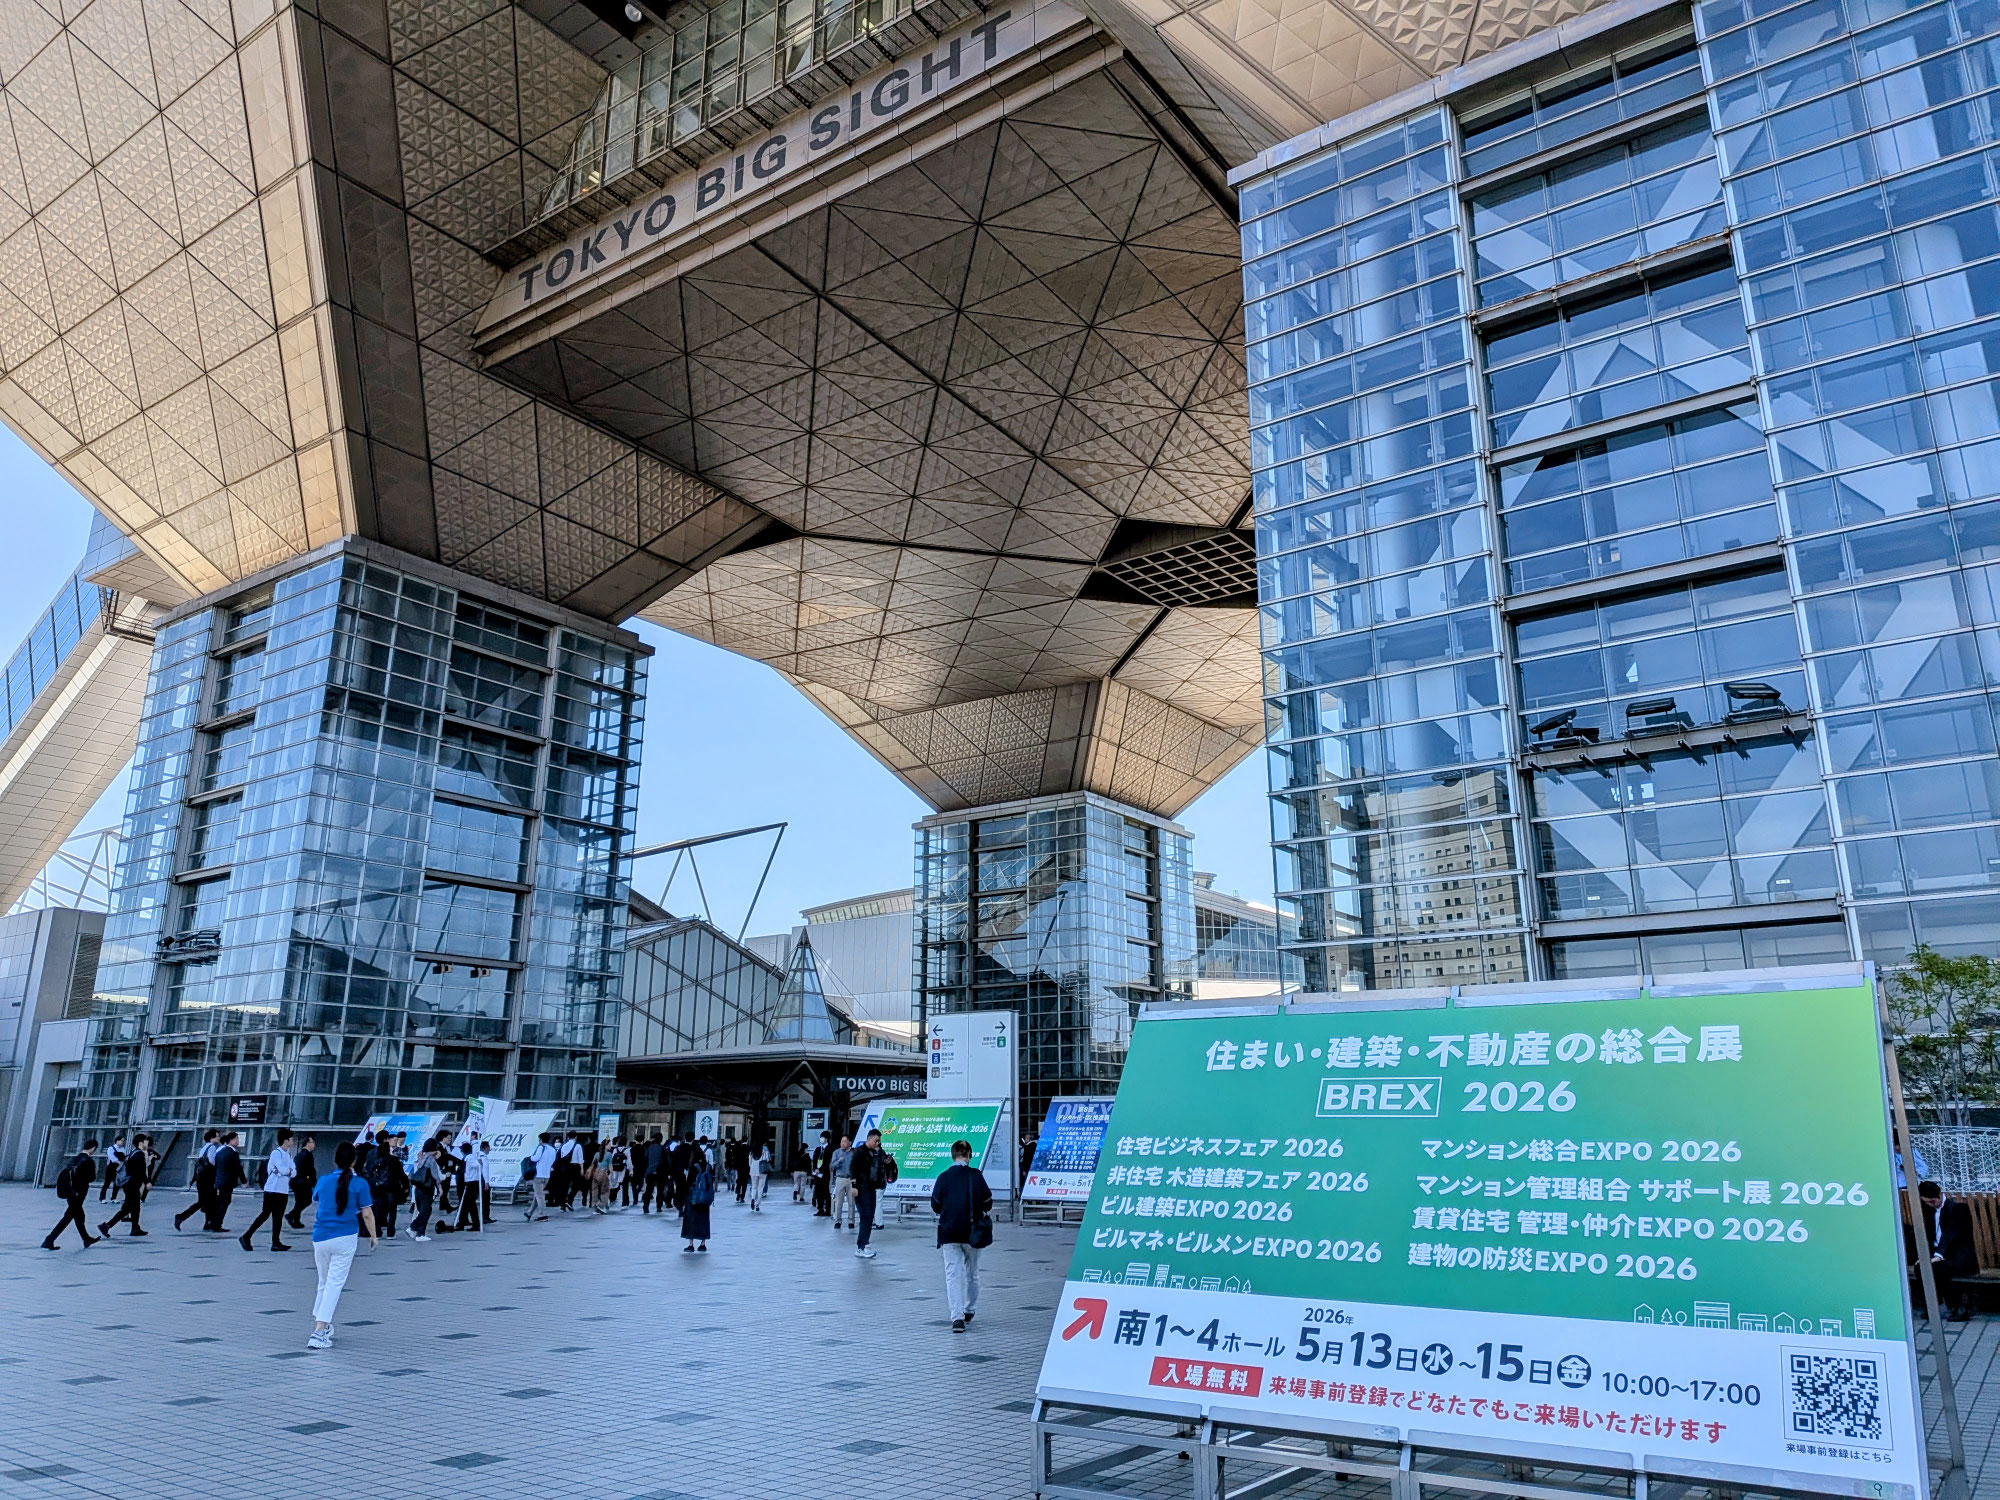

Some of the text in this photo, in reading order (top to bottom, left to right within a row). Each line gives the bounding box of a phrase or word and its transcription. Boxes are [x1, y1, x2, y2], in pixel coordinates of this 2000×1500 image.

[518, 10, 1012, 302] TOKYO BIG SIGHT
[1205, 1024, 1743, 1072] 住まい・建築・不動産の総合展
[836, 1077, 886, 1091] TOKYO
[890, 1079, 910, 1091] BIG
[1323, 1080, 1577, 1112] BREX 2026
[493, 1133, 528, 1147] EDIX
[897, 1123, 988, 1134] 自治体・公共 Week 2026
[1116, 1136, 1279, 1158] 住宅ビジネスフェア
[1282, 1137, 1344, 1158] 2026
[1421, 1138, 1742, 1163] マンション総合EXPO 2026
[1106, 1165, 1369, 1192] 非住宅 木造建築フェア 2026
[1416, 1175, 1870, 1207] マンション管理組合 サポート展 2026
[1100, 1194, 1293, 1222] ビル建築EXPO 2026
[1411, 1206, 1810, 1244] 賃貸住宅 管理・仲介EXPO 2026
[1092, 1227, 1382, 1264] ビルマネ・ビルメンEXPO 2026
[1407, 1242, 1698, 1282] 建物の防災EXPO 2026
[1303, 1307, 1354, 1326] 2026年
[1161, 1362, 1727, 1444] 入場無料 来場事前登録でどなたでもご来場いただけます
[1785, 1442, 1893, 1464] 来場事前登録はこちら
